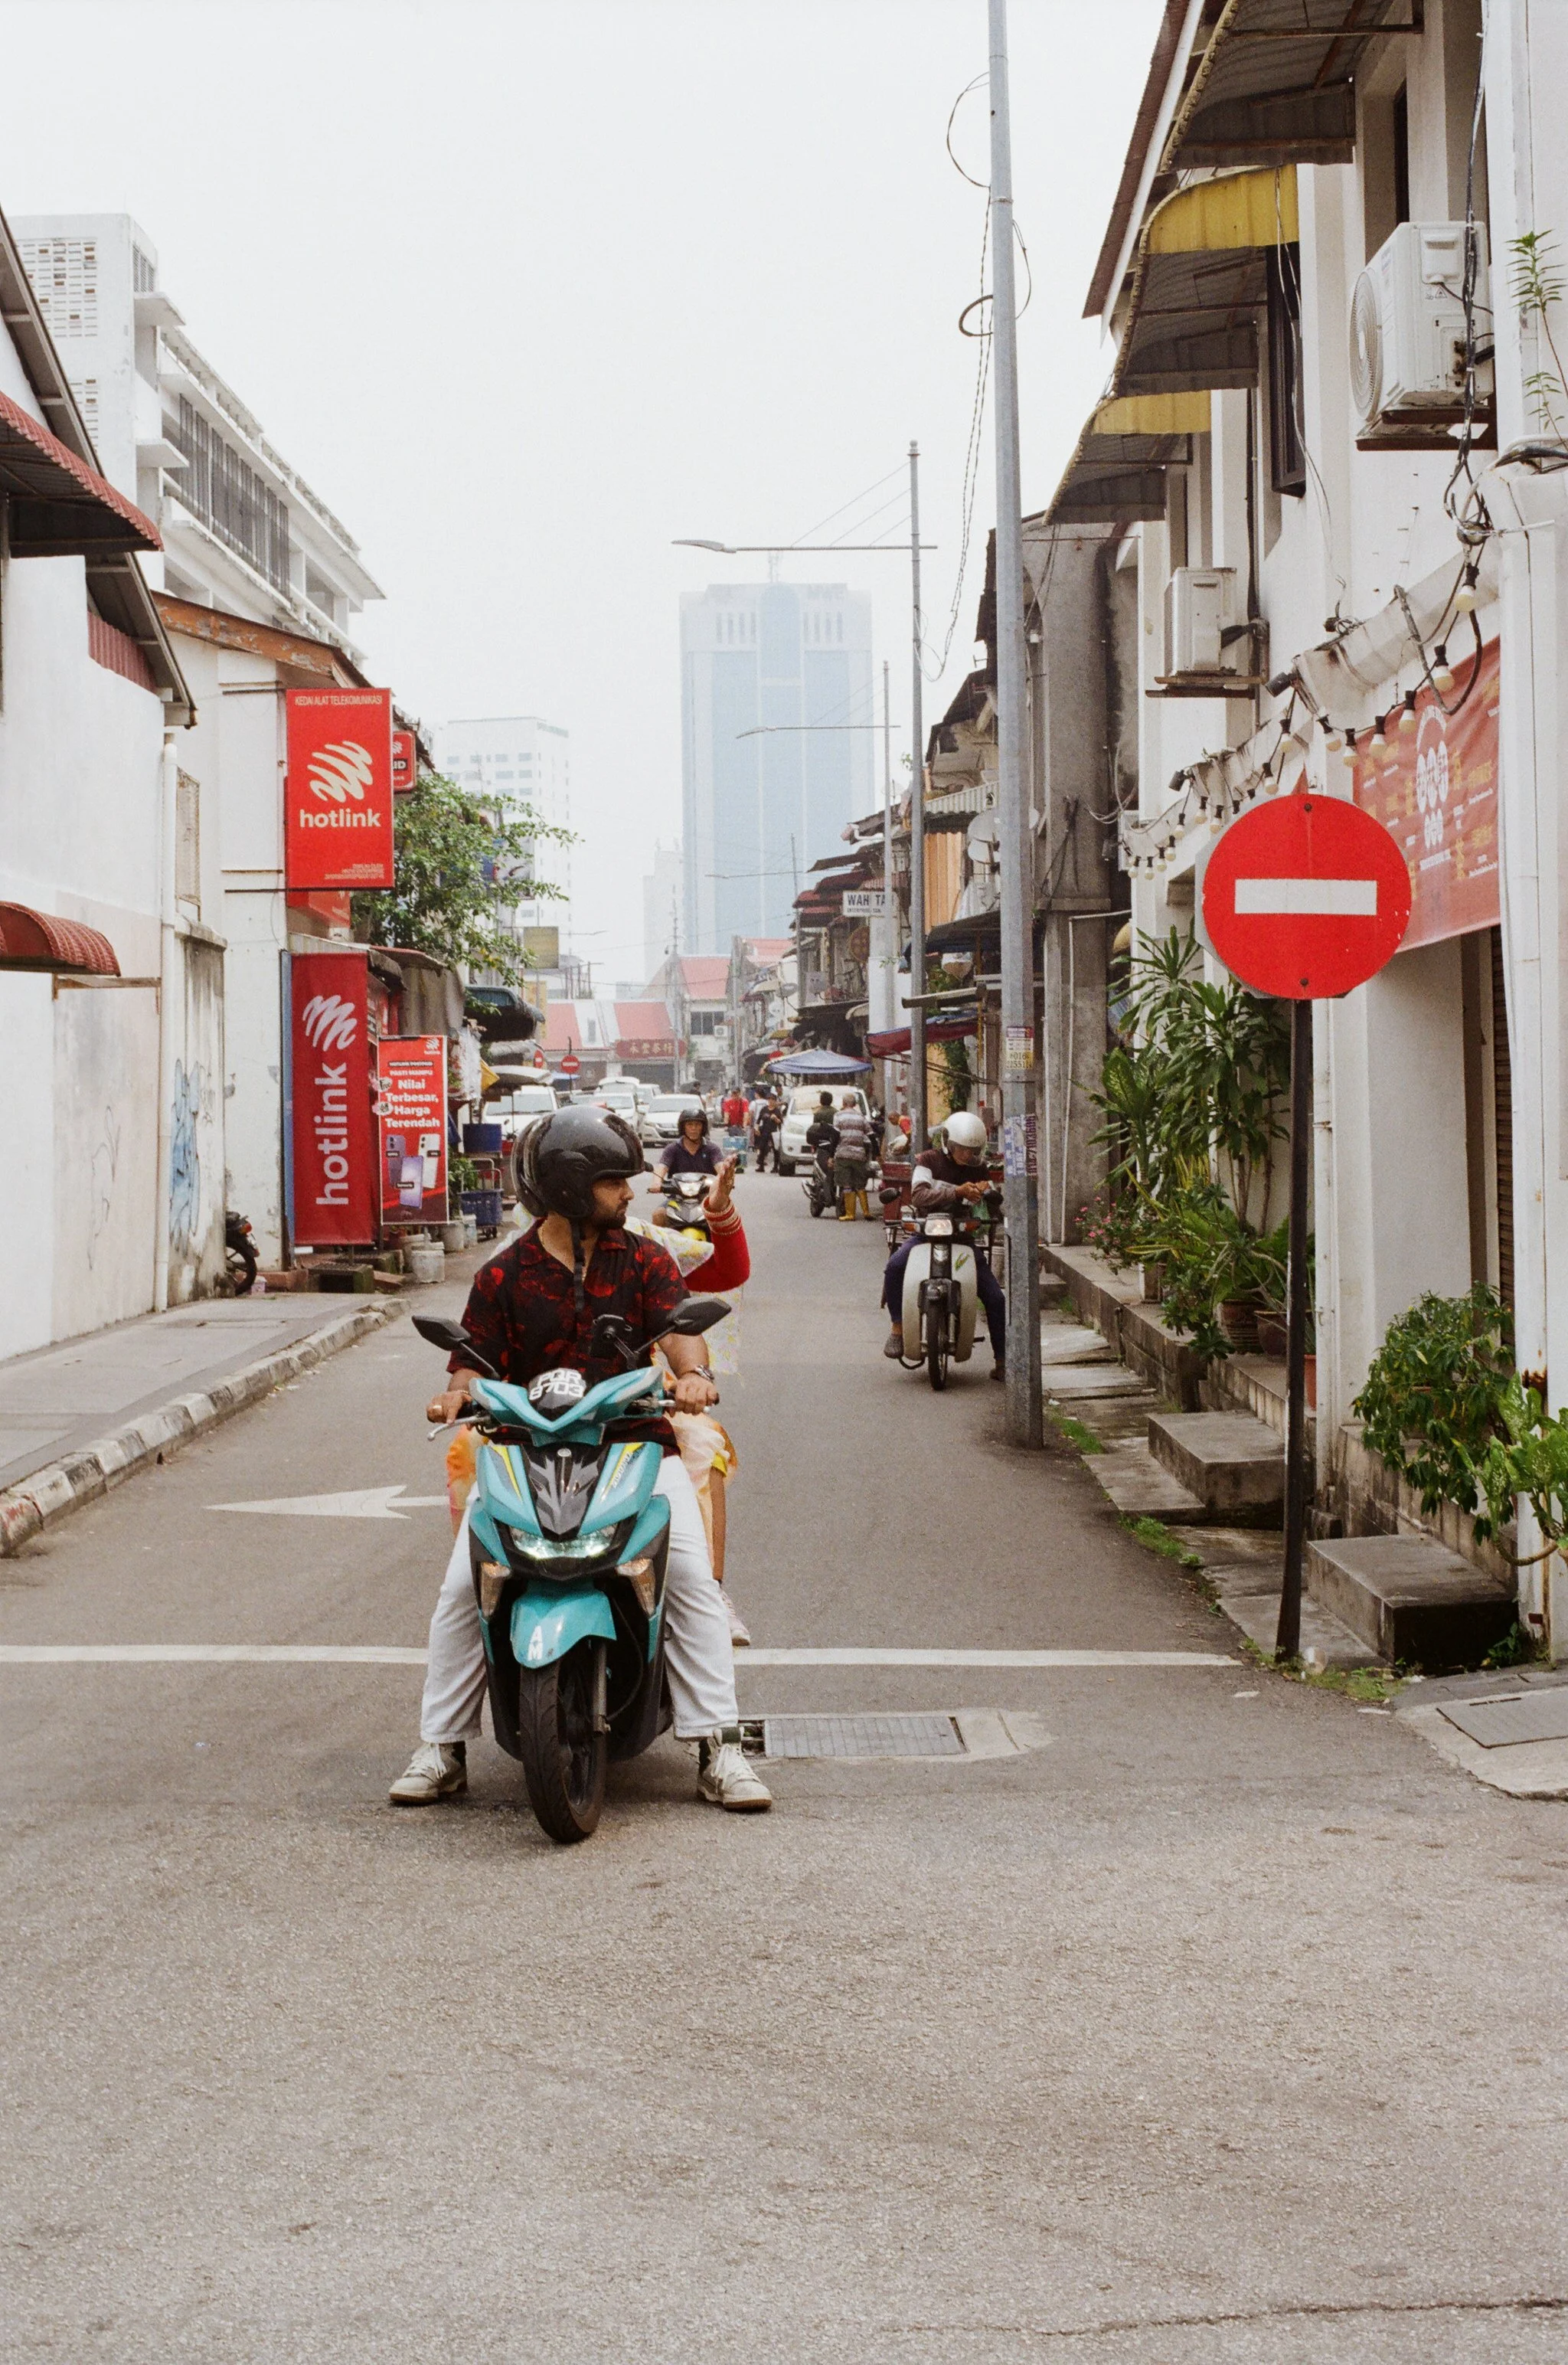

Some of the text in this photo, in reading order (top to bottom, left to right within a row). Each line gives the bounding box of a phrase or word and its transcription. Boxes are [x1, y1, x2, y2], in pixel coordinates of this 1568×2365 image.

[295, 695, 382, 705] KEDAI ALAT TELEKOMUNIKASI
[299, 808, 381, 828] hotlink
[848, 895, 869, 905] WAH
[397, 1078, 426, 1089] Nilai
[385, 1093, 439, 1103] Terbesar,
[394, 1105, 431, 1117] Harga
[385, 1117, 440, 1127] Terendah
[313, 1062, 349, 1205] hotlink
[537, 1368, 582, 1386] PQR
[529, 1382, 584, 1400] 8703
